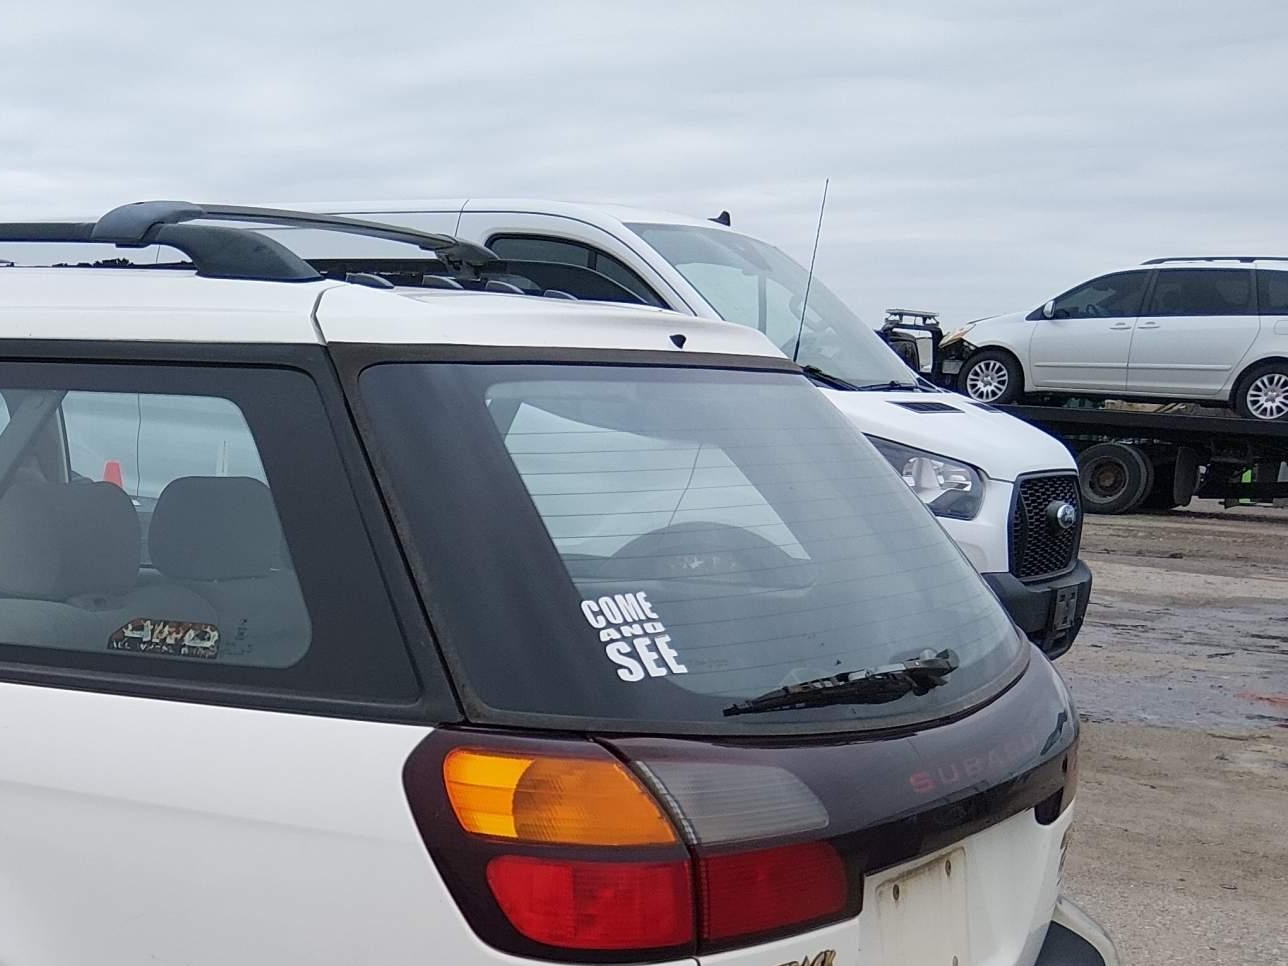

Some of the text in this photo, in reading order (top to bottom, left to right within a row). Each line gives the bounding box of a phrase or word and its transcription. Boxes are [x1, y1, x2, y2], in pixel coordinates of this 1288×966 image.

[580, 591, 659, 629] COME
[599, 621, 666, 642] AND
[606, 634, 689, 682] SEE
